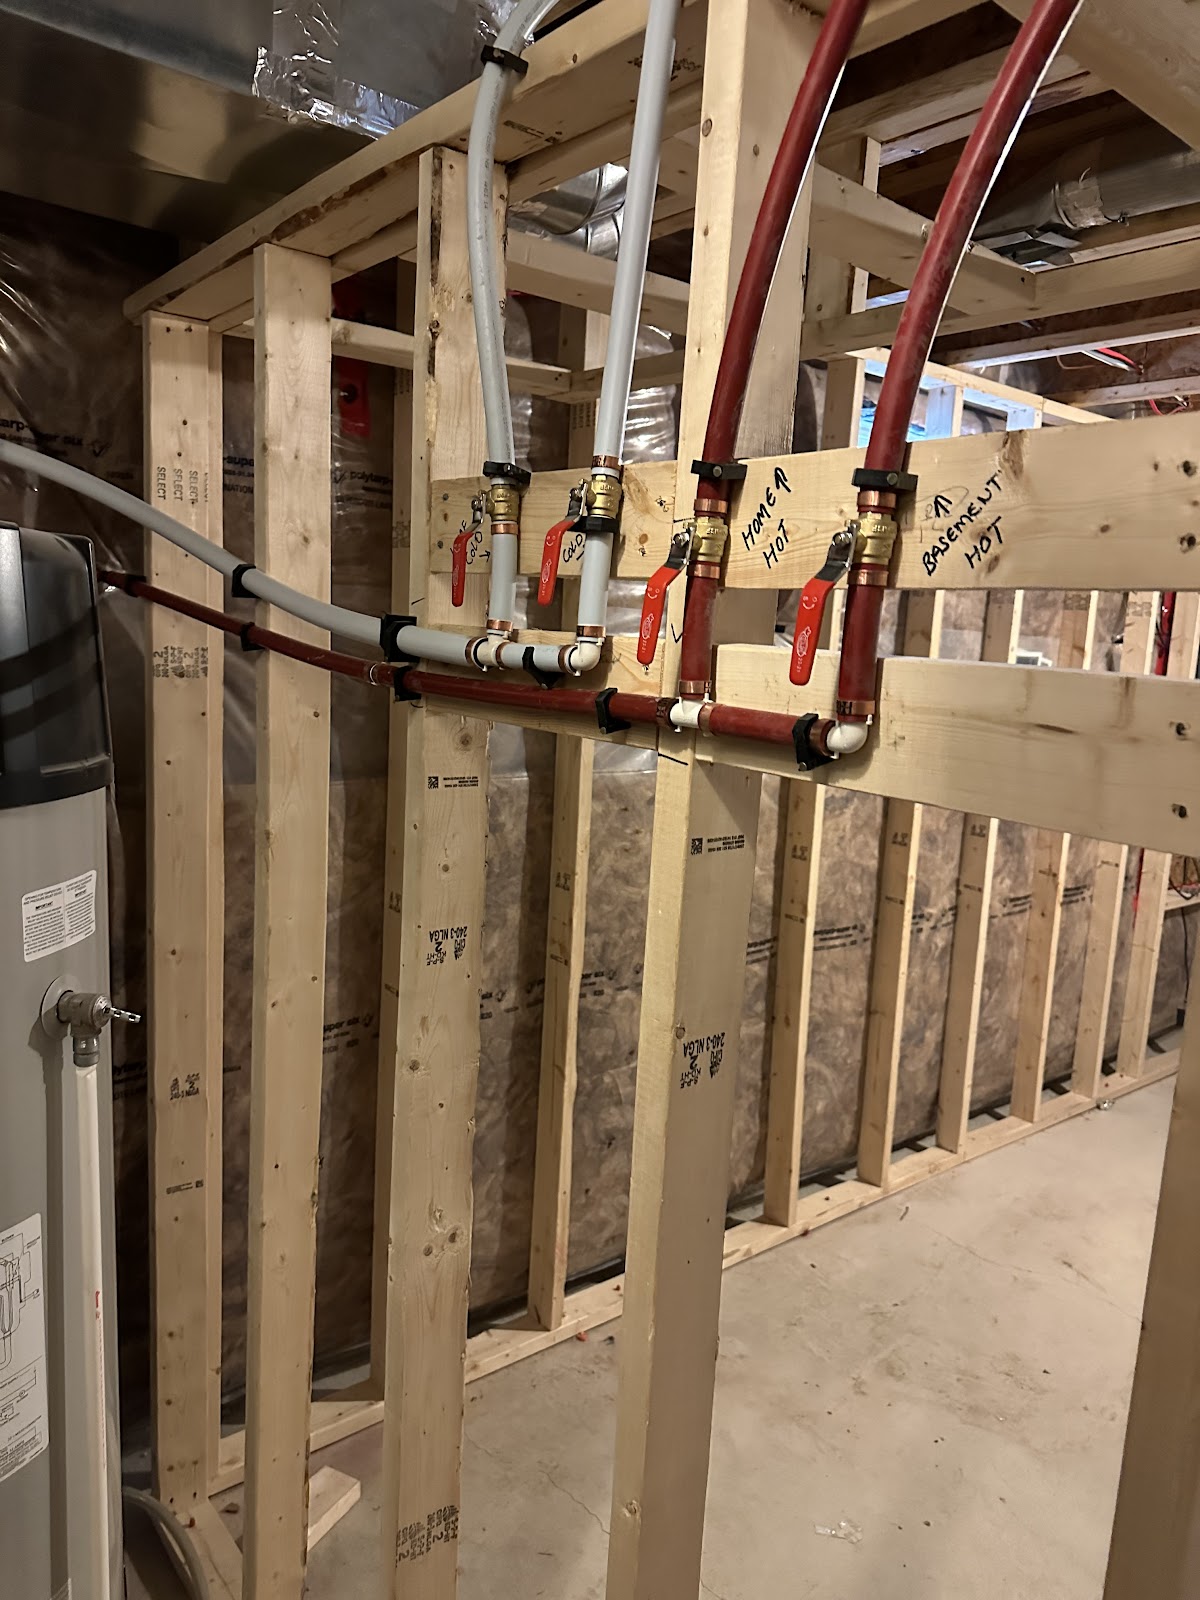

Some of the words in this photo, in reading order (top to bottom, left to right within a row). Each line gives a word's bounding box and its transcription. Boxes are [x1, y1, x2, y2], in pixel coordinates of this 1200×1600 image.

[157, 466, 166, 500] SELECT
[189, 470, 199, 503] SELECT
[742, 487, 776, 551] HOME
[922, 470, 1003, 576] BASEMENT
[763, 518, 789, 569] HOT
[965, 516, 1003, 569] HOT
[429, 928, 449, 943] NLGA
[450, 926, 468, 939] 240-3
[435, 941, 443, 953] 2
[426, 957, 444, 966] S-P-F
[683, 1038, 705, 1058] NLGA
[705, 1032, 725, 1051] 240-3
[690, 1055, 699, 1070] 2
[432, 1531, 444, 1544] 2
[398, 1549, 410, 1562] 2
